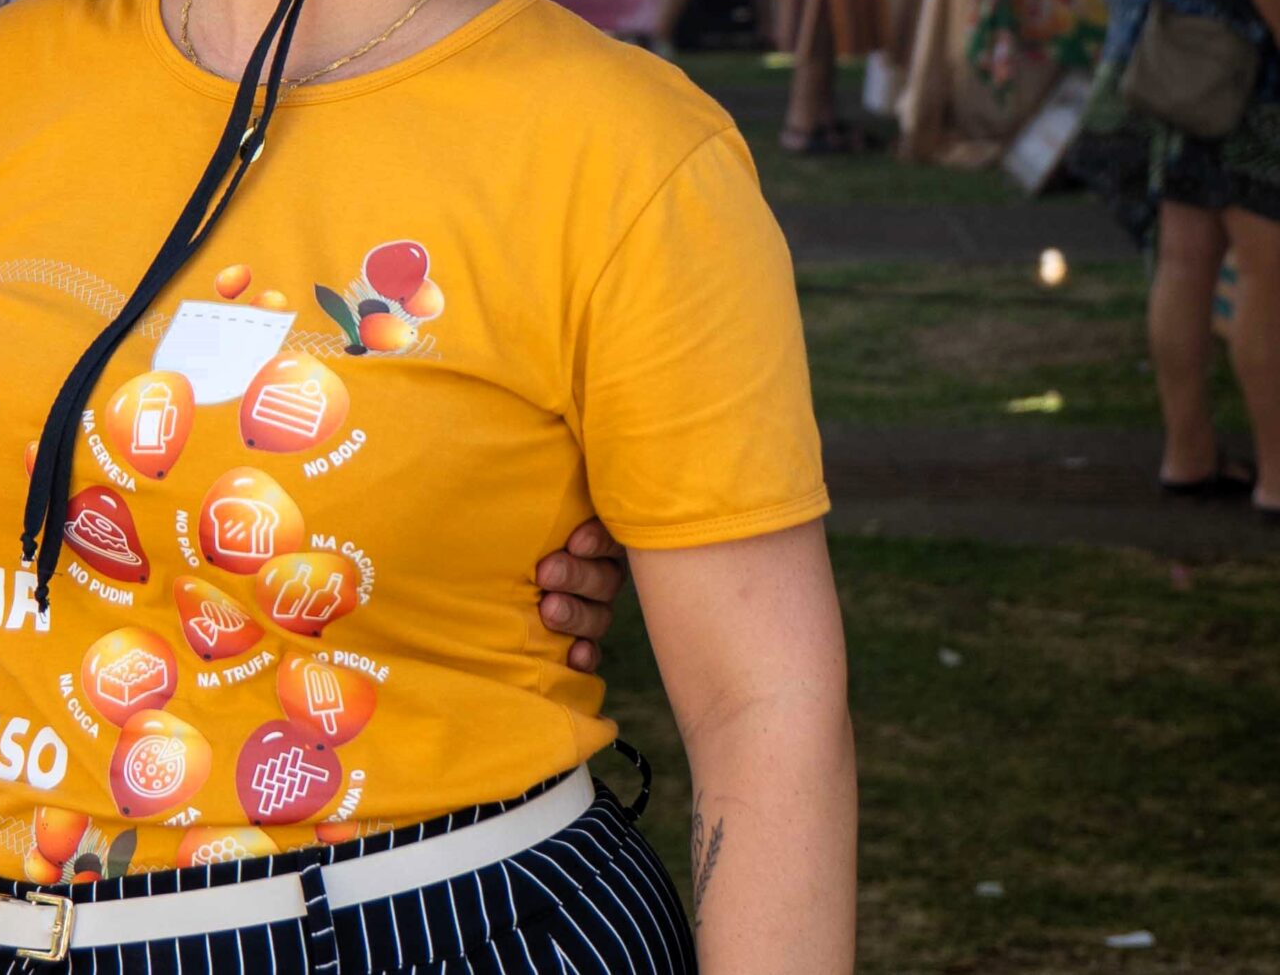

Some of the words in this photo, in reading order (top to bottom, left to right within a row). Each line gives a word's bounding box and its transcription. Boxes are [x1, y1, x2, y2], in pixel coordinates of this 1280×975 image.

[82, 409, 95, 434] NA
[88, 434, 137, 492] CERVEJA
[303, 457, 329, 478] NO
[328, 428, 367, 466] BOLO
[176, 509, 188, 533] NO
[177, 536, 200, 568] PÃO
[311, 534, 337, 551] NA
[340, 541, 375, 604] CACHAÇA
[68, 561, 89, 584] NO
[89, 578, 134, 606] PUDIM
[197, 672, 221, 688] NA
[223, 650, 275, 684] TRUFA
[333, 650, 390, 684] PICOLÉ
[60, 673, 74, 698] NA
[68, 697, 100, 738] CUCA
